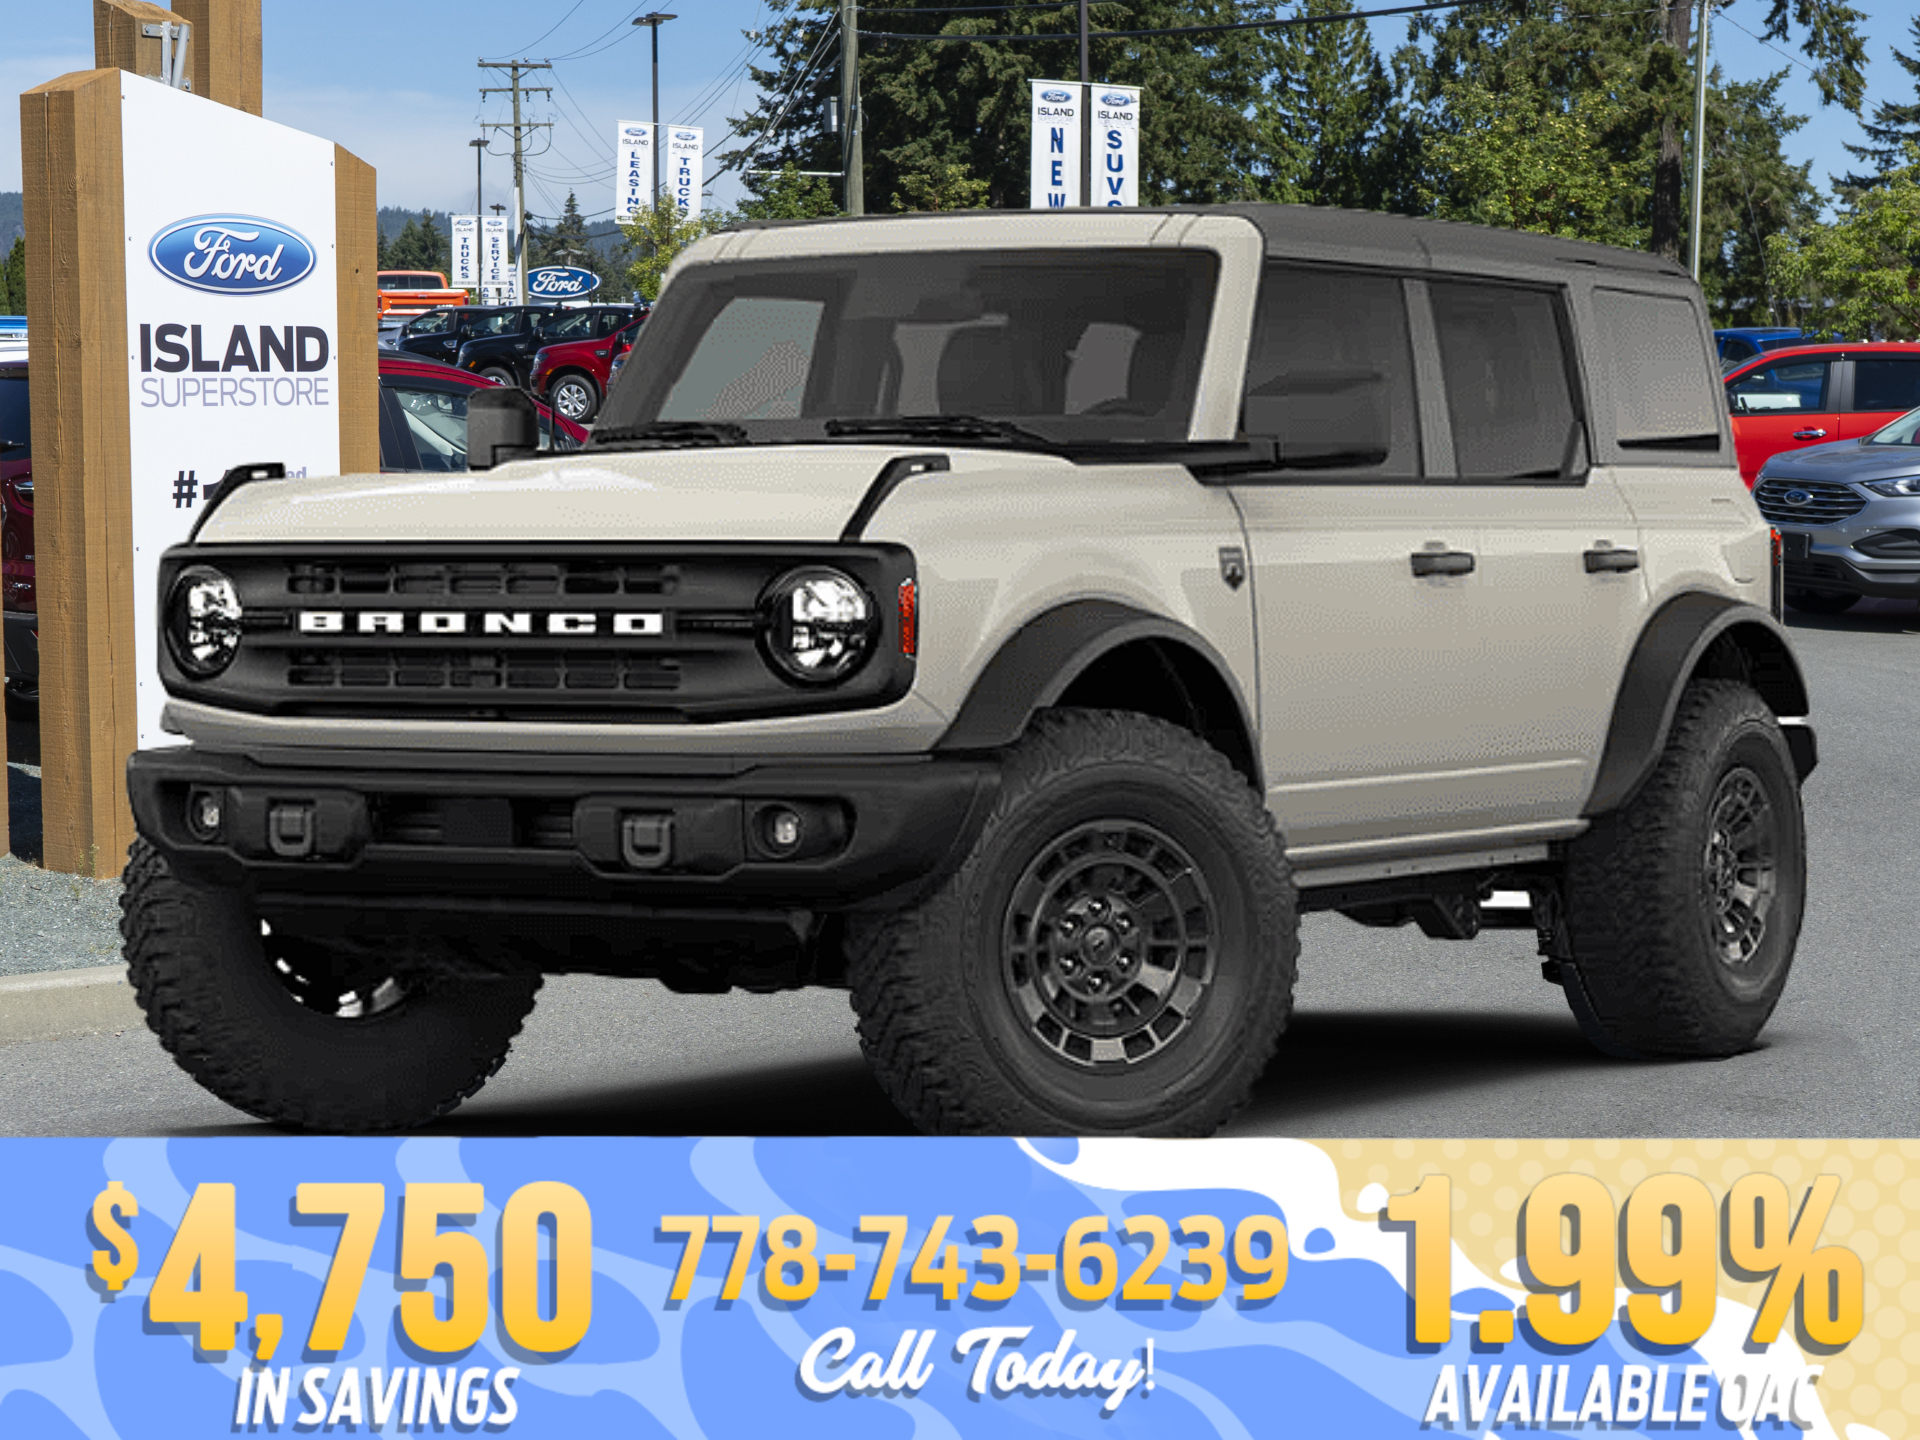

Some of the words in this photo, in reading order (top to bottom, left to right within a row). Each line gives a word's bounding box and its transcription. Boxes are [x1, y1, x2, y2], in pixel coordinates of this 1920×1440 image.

[1046, 91, 1067, 102] Ford
[1105, 95, 1126, 106] Ford
[1037, 107, 1074, 117] ISLAND
[1097, 110, 1133, 121] ISLAND
[622, 138, 648, 146] ISLAND
[672, 142, 698, 150] ISLAND
[1048, 127, 1066, 209] NEW
[627, 151, 640, 214] LEASING
[678, 156, 691, 217] TRUCKS
[184, 226, 284, 281] Ford
[460, 236, 470, 279] TRUCKS
[491, 236, 500, 281] SERVICE
[532, 271, 584, 292] Ford
[140, 323, 329, 373] ISLAND
[140, 377, 329, 408] SUPERSTORE
[299, 611, 663, 634] BRONCO
